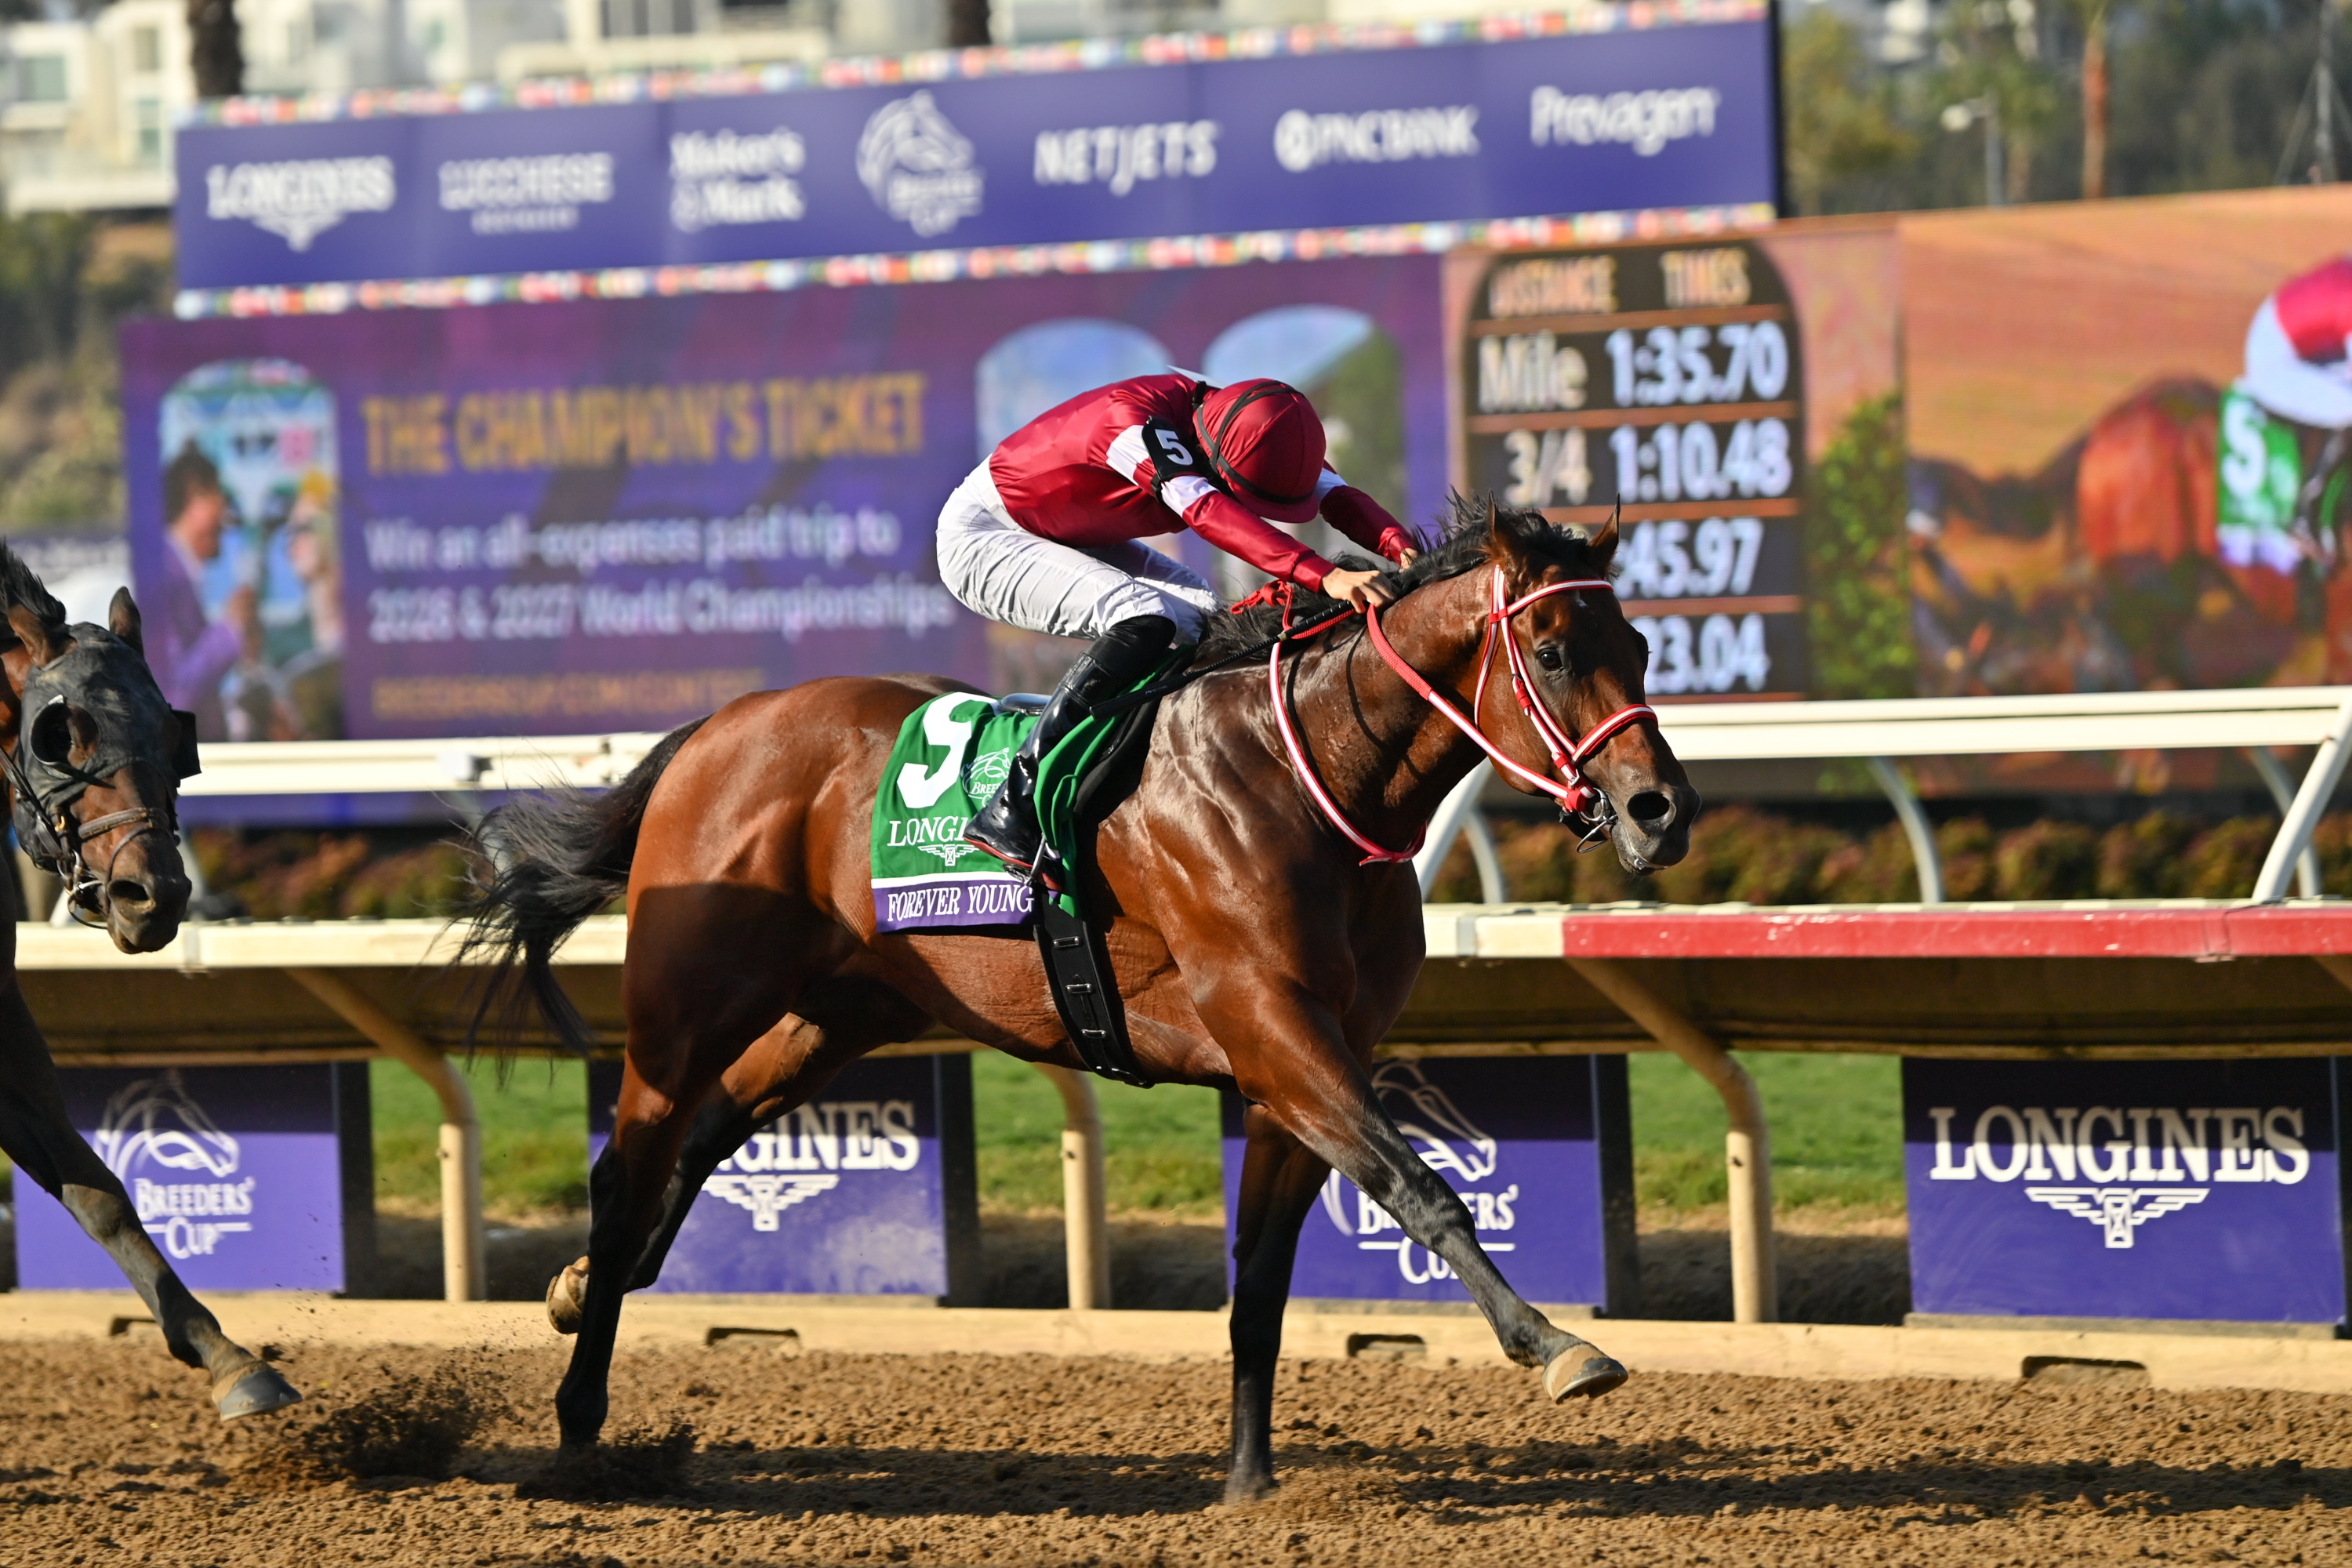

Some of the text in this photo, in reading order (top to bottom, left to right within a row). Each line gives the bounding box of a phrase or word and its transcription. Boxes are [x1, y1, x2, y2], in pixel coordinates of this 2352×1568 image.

[1530, 85, 1719, 155] Prevagen
[207, 156, 394, 219] LONGINES
[1034, 119, 1221, 196] NETJETS
[1479, 330, 1588, 414] Mile
[1605, 319, 1788, 407] 1:35.70
[363, 392, 450, 477] THE
[765, 371, 926, 458] TICKET
[1154, 428, 1193, 466] 5
[1504, 425, 1592, 507] 3/4
[1608, 416, 1792, 504] 1:10.48
[365, 517, 427, 572] Win
[858, 506, 902, 556] to
[578, 579, 681, 636] World
[887, 815, 969, 846] LONGI
[887, 884, 1035, 922] FOREVER YOUNG
[1929, 1105, 2310, 1185] LONGINES
[1398, 1236, 1460, 1284] CU
